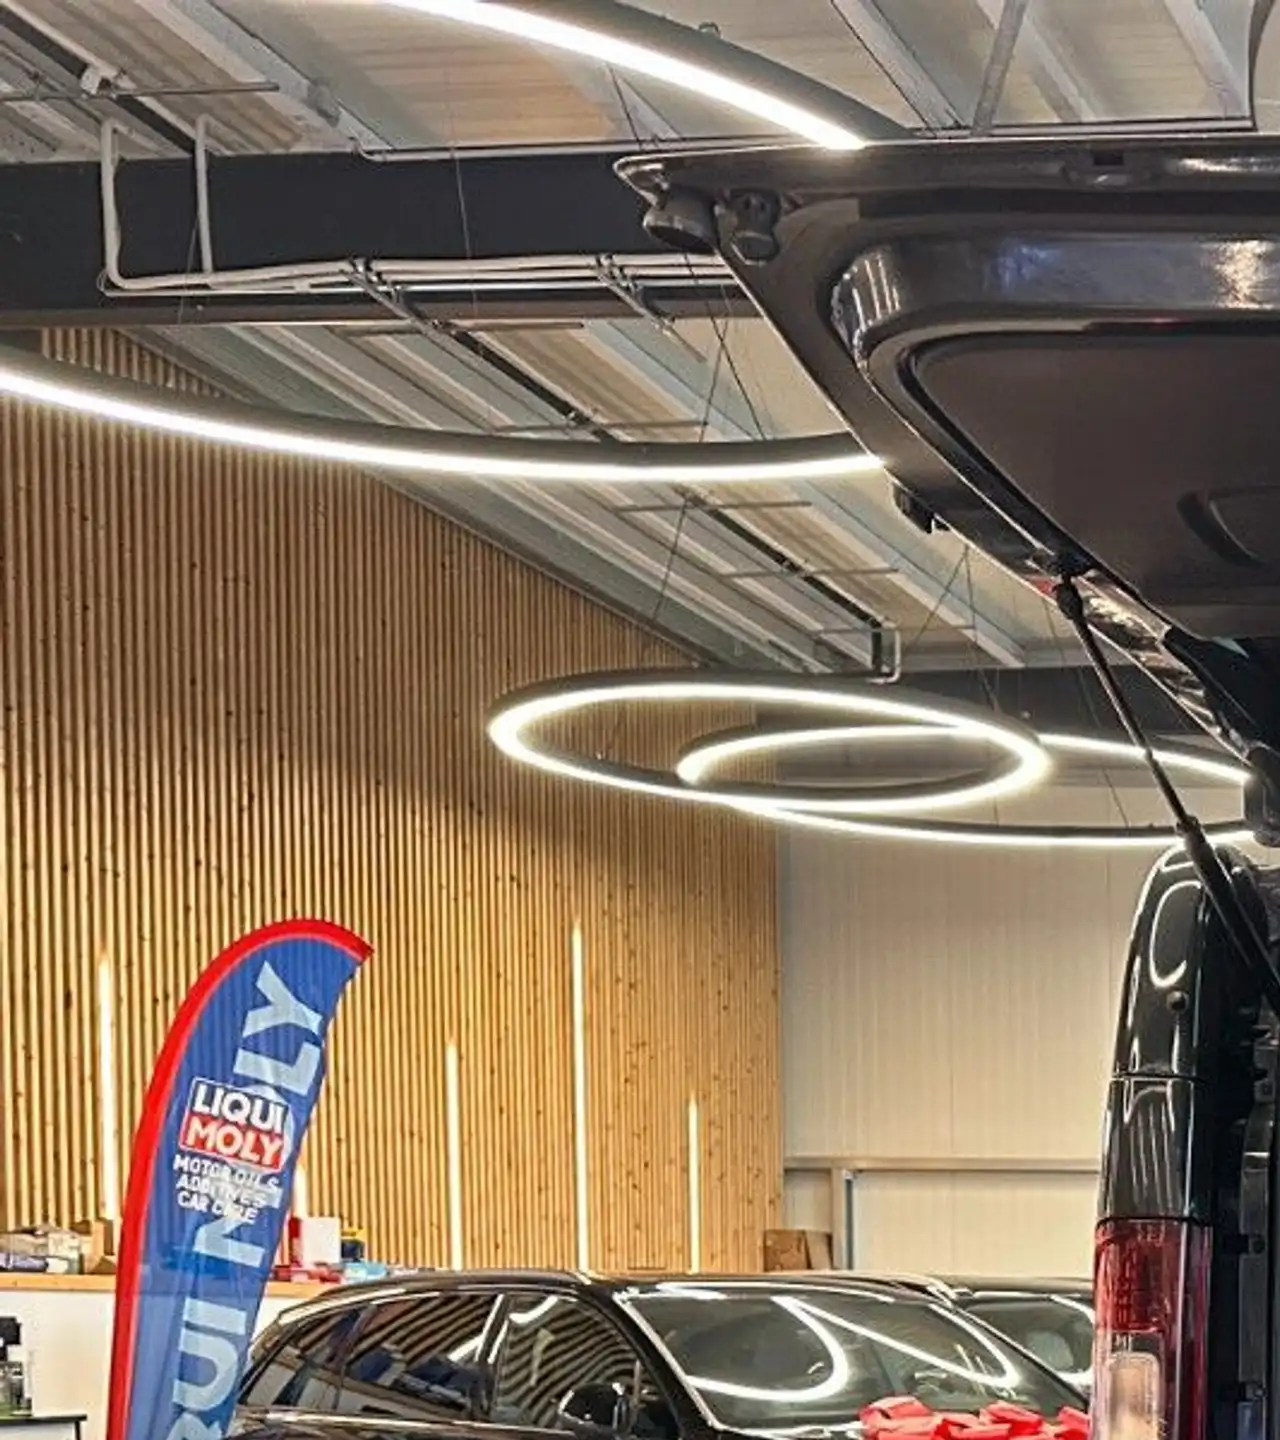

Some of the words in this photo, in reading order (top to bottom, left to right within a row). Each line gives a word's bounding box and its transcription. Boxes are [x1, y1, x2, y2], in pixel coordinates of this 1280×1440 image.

[191, 1083, 286, 1135] LIQUI
[186, 1116, 283, 1166] MOLY
[176, 1190, 209, 1213] CAR
